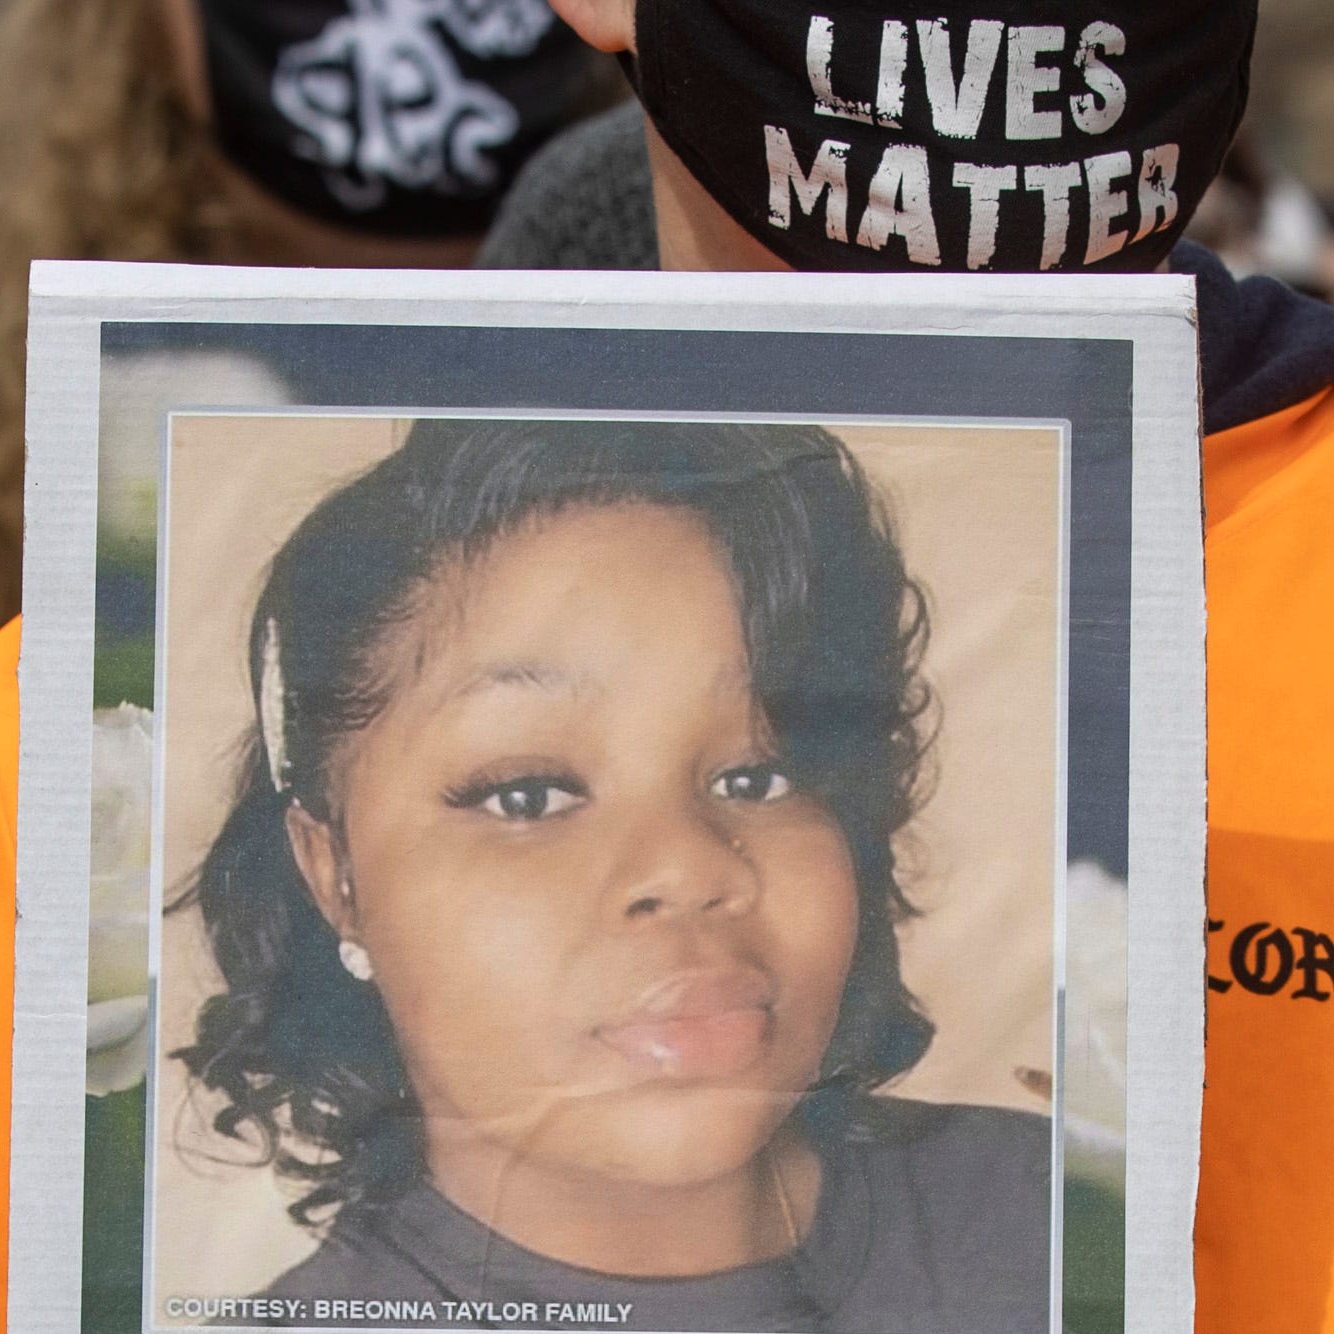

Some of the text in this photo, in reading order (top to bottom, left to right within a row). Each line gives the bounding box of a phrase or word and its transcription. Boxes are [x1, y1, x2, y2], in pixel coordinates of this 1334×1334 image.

[805, 15, 1128, 140] LIVES
[763, 124, 1181, 271] MATTER
[166, 1297, 634, 1324] COURTESY: BREONNA TAYLOR FAMILY
